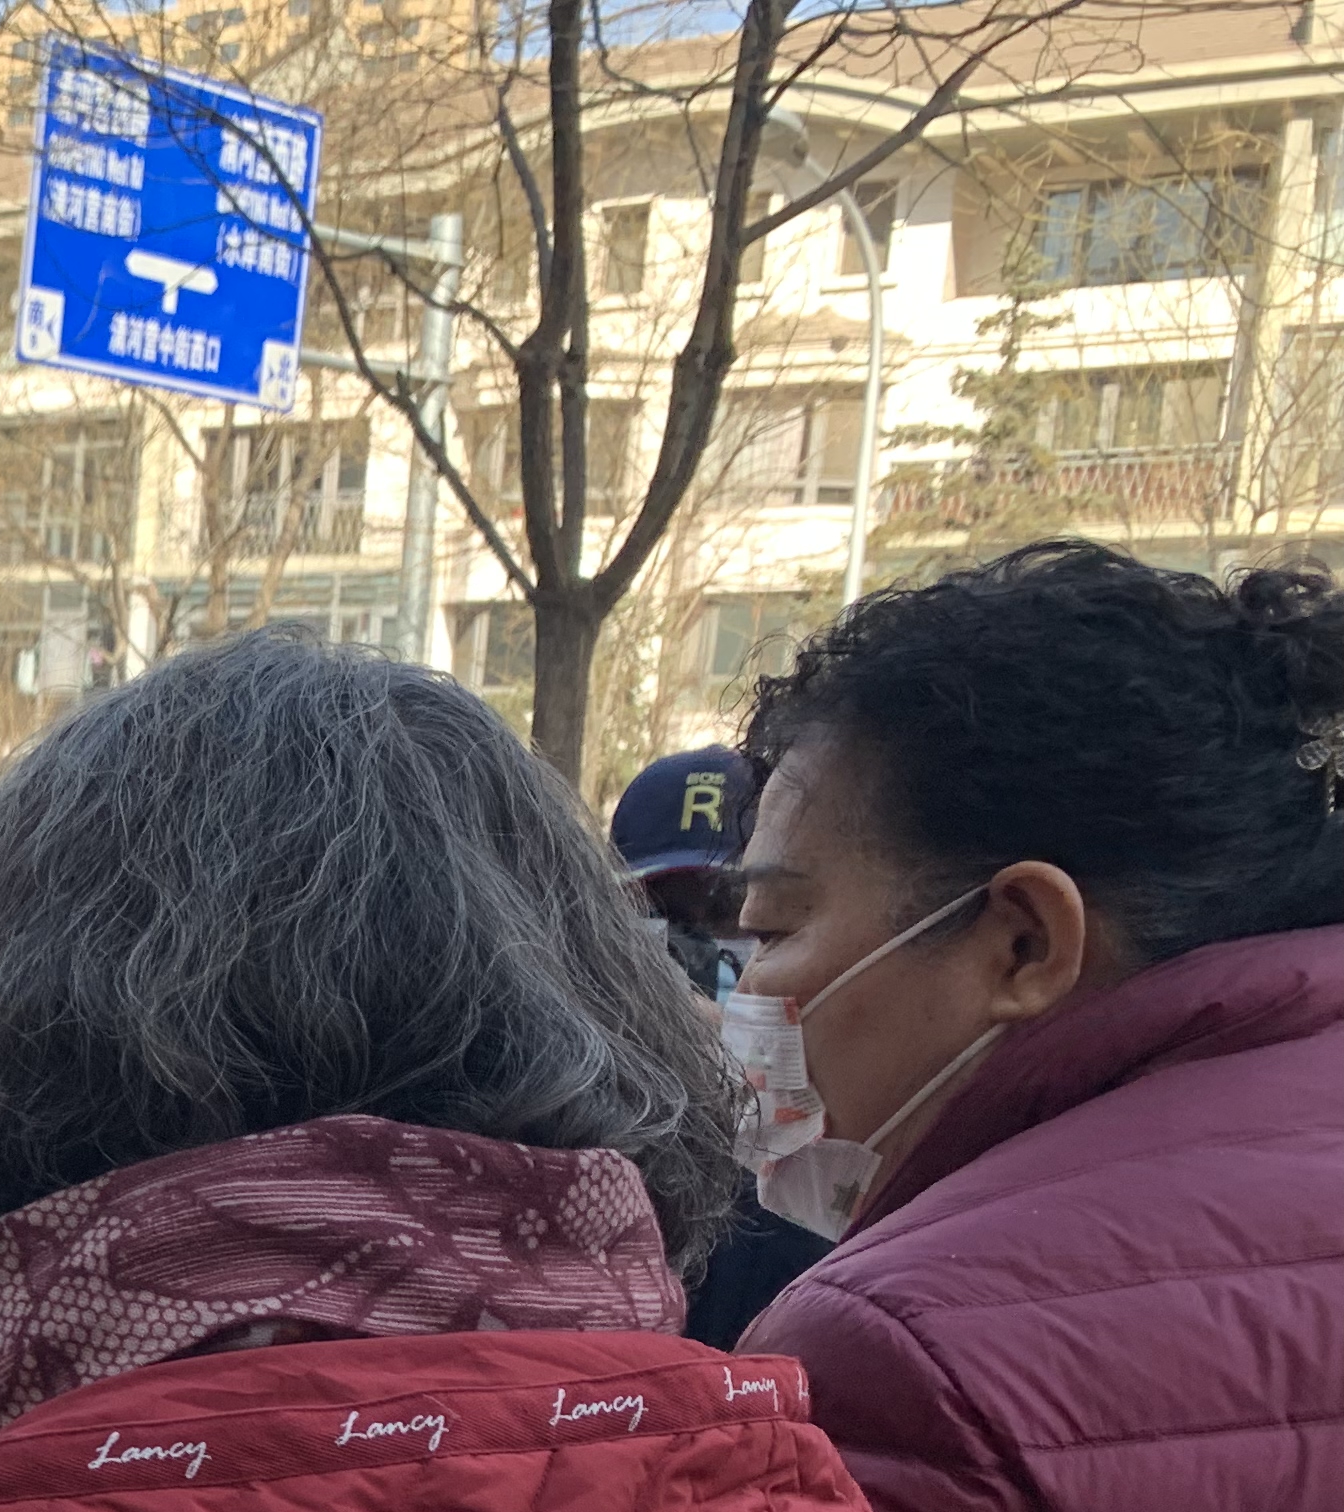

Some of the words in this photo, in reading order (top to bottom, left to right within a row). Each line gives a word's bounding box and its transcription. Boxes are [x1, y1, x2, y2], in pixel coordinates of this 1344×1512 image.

[681, 783, 723, 832] R
[551, 1387, 650, 1432] Lancy
[723, 1365, 779, 1412] Lancy
[337, 1407, 450, 1450] Lancy
[88, 1431, 212, 1478] Lancy
